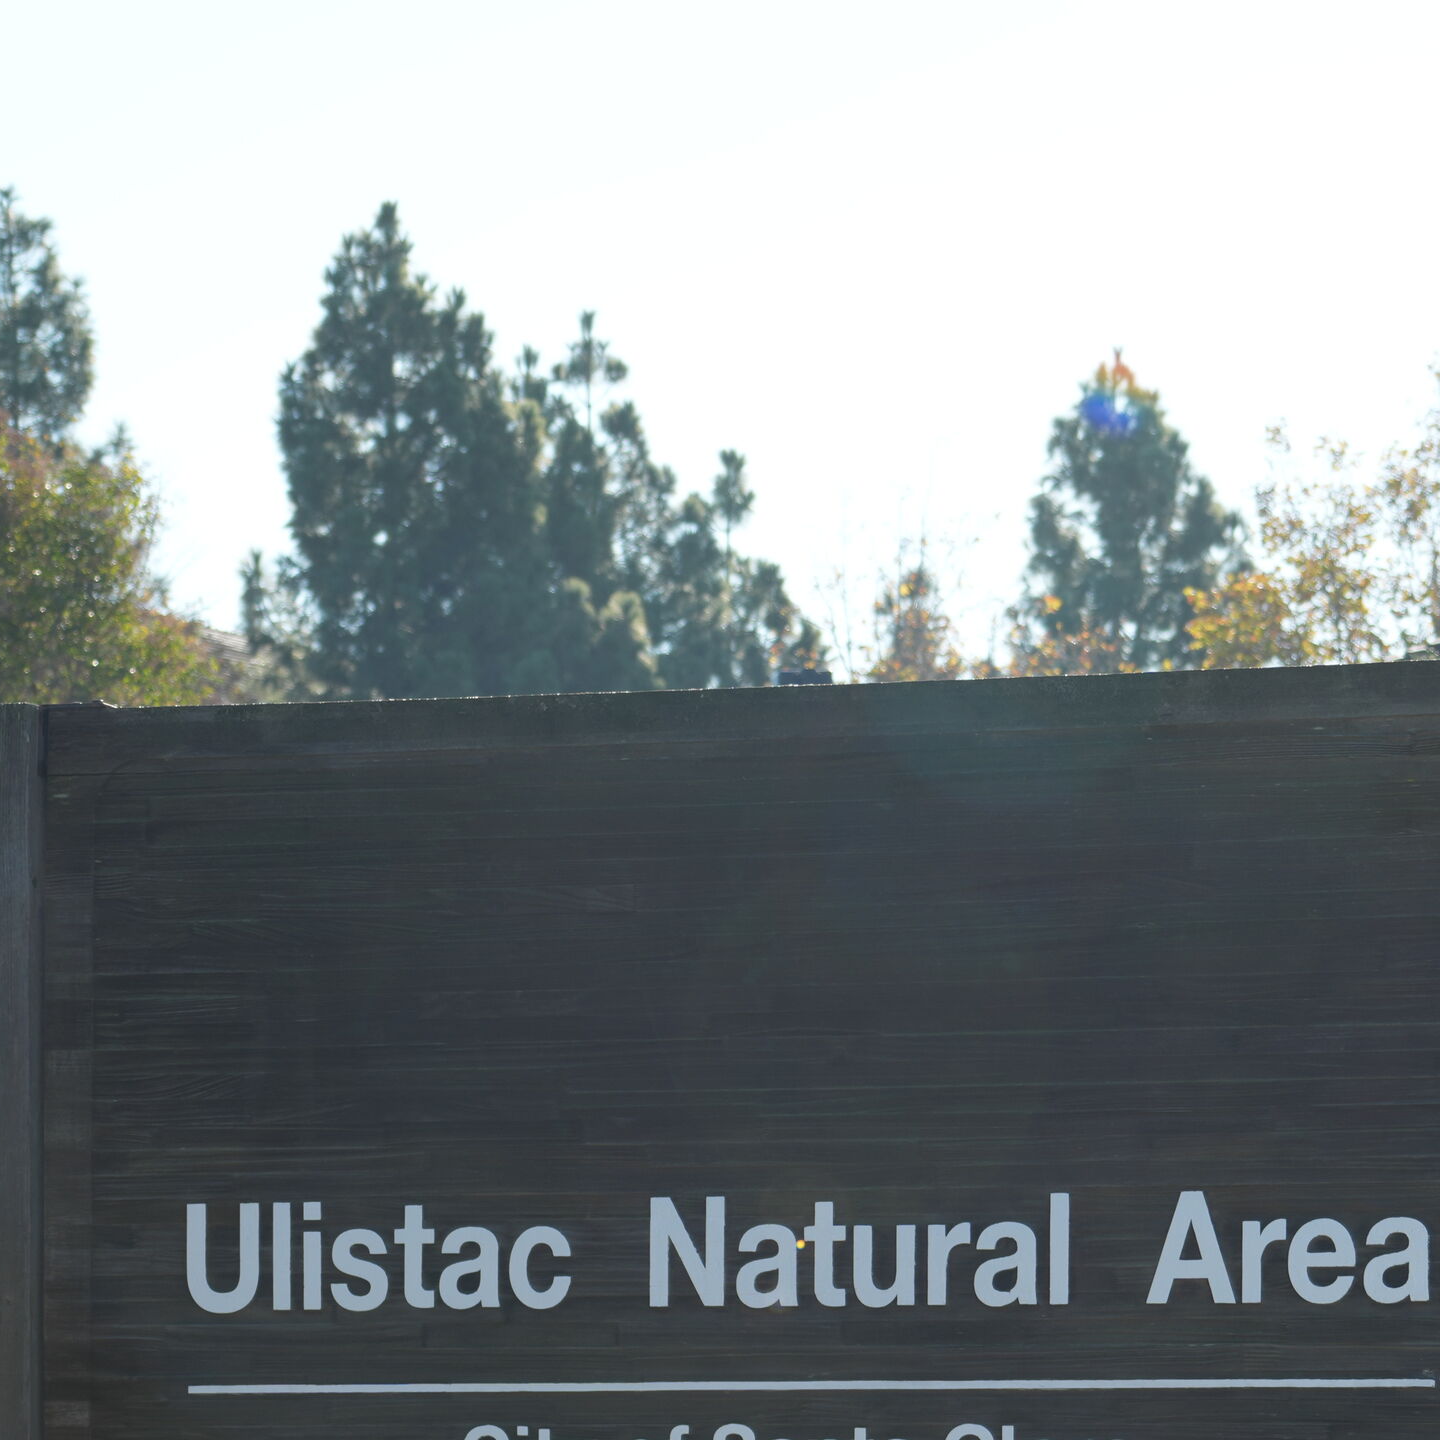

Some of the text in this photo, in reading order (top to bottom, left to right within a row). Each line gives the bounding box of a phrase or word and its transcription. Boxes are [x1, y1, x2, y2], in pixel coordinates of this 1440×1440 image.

[185, 1190, 1431, 1314] Ulistac Natural Area
